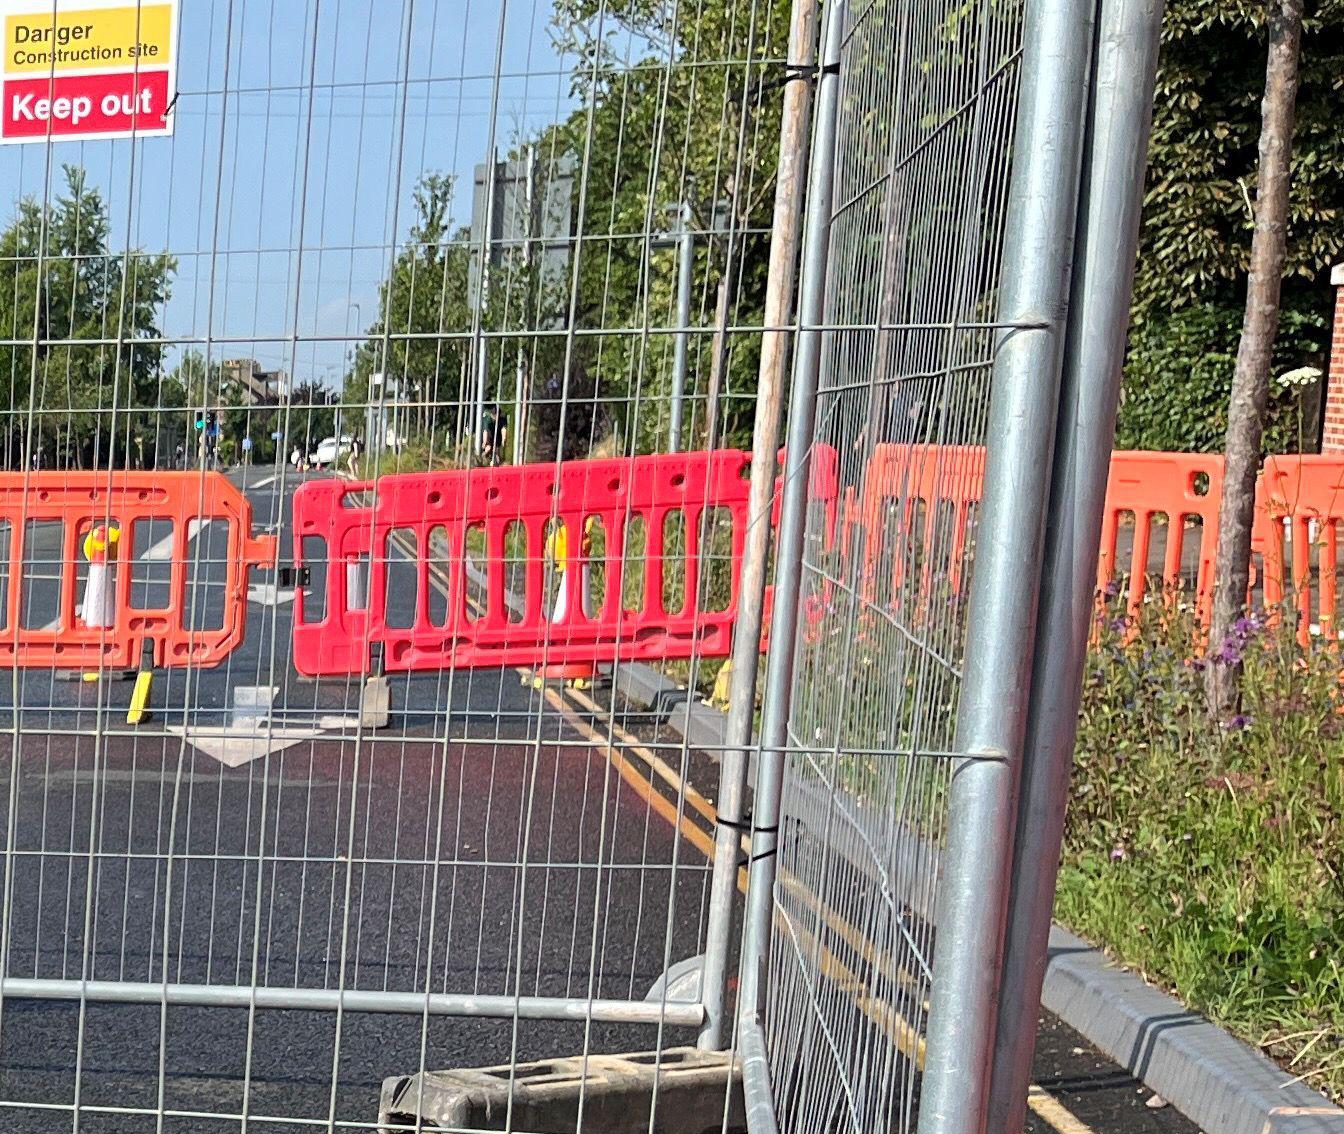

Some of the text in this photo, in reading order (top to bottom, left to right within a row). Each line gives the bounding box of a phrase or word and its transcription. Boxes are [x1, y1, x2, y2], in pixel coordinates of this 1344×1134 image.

[15, 25, 93, 45] Danger
[14, 43, 158, 65] Construction site
[12, 87, 152, 124] Keep out
